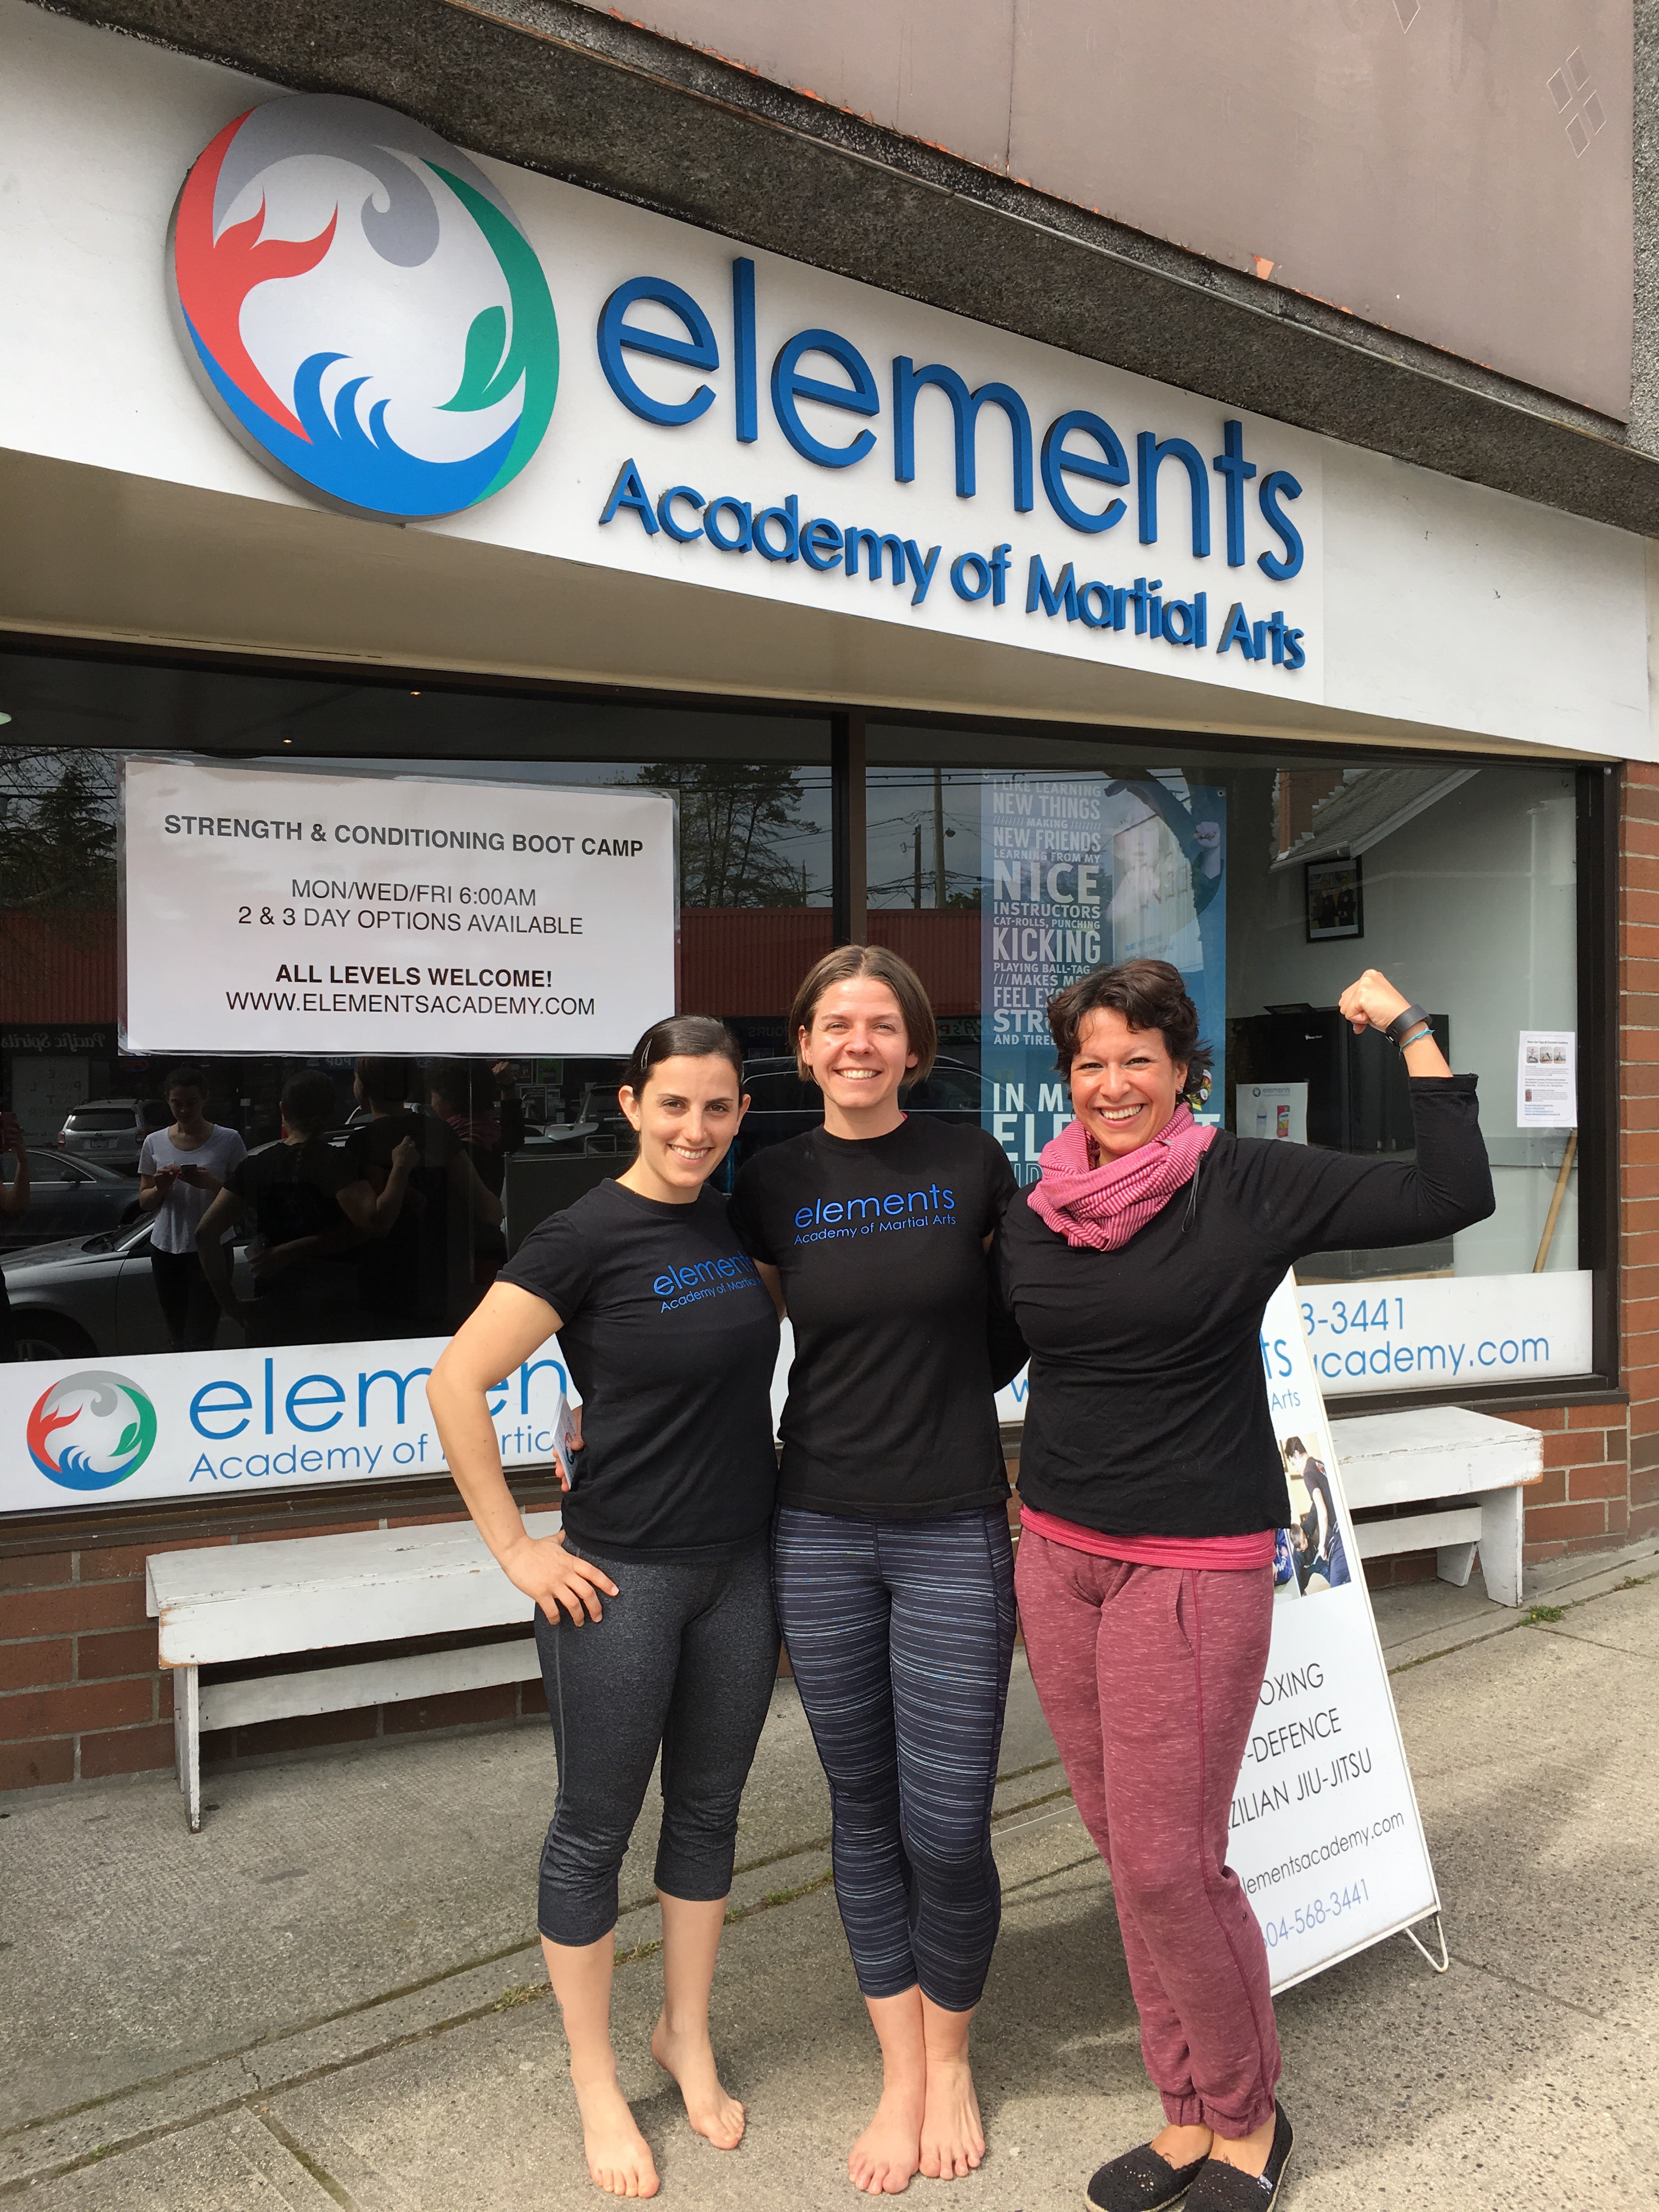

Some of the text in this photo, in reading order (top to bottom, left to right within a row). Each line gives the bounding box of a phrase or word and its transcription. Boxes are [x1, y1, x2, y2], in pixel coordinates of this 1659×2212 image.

[597, 256, 1304, 582] elements
[599, 458, 1306, 670] Academy of Martial Arts
[1003, 780, 1031, 792] LIKE
[1036, 782, 1101, 797] LEARNING
[994, 792, 1100, 820] NEW THINGS
[164, 814, 644, 857] STRENGTH & CONDITIONING BOOT CAMP
[1027, 818, 1068, 828] MAKING
[994, 826, 1101, 852] NEW FRIENDS
[994, 849, 1101, 863] LEARNING FROM MY
[291, 879, 537, 906] MON/WED/FRI 6:00AM
[994, 860, 1101, 904] NICE
[239, 906, 583, 935] 2 & 3 DAY OPTIONS AVAILABLE
[994, 901, 1101, 919] INSTRUCTORS
[994, 916, 1101, 929] CAT-ROLLS, PUNCHING
[993, 927, 1101, 963] KICKING
[275, 964, 552, 989] ALL LEVELS WELCOME!
[994, 962, 1090, 974] PLAYING BALL-TAG
[226, 991, 595, 1017] WWW.ELEMENTSACADEMY.COM
[994, 986, 1030, 1007] FEEL
[993, 1008, 1053, 1032] STR
[994, 1034, 1019, 1045] AND
[994, 1083, 1024, 1111] IN
[795, 1184, 955, 1228] elements
[794, 1214, 956, 1245] Academy of Martial Arts
[661, 1287, 716, 1313] Academy
[716, 1283, 726, 1294] of
[1313, 1337, 1549, 1378] cademy.com
[1272, 1389, 1301, 1411] Arts
[189, 1444, 382, 1482] Academy
[393, 1434, 428, 1464] of
[1259, 1663, 1324, 1706] OXING
[1239, 1707, 1341, 1770] -DEFENCE
[1228, 1747, 1372, 1830] ZILIAN JIU-JITSU
[1242, 1812, 1404, 1897] lementsacademy.com
